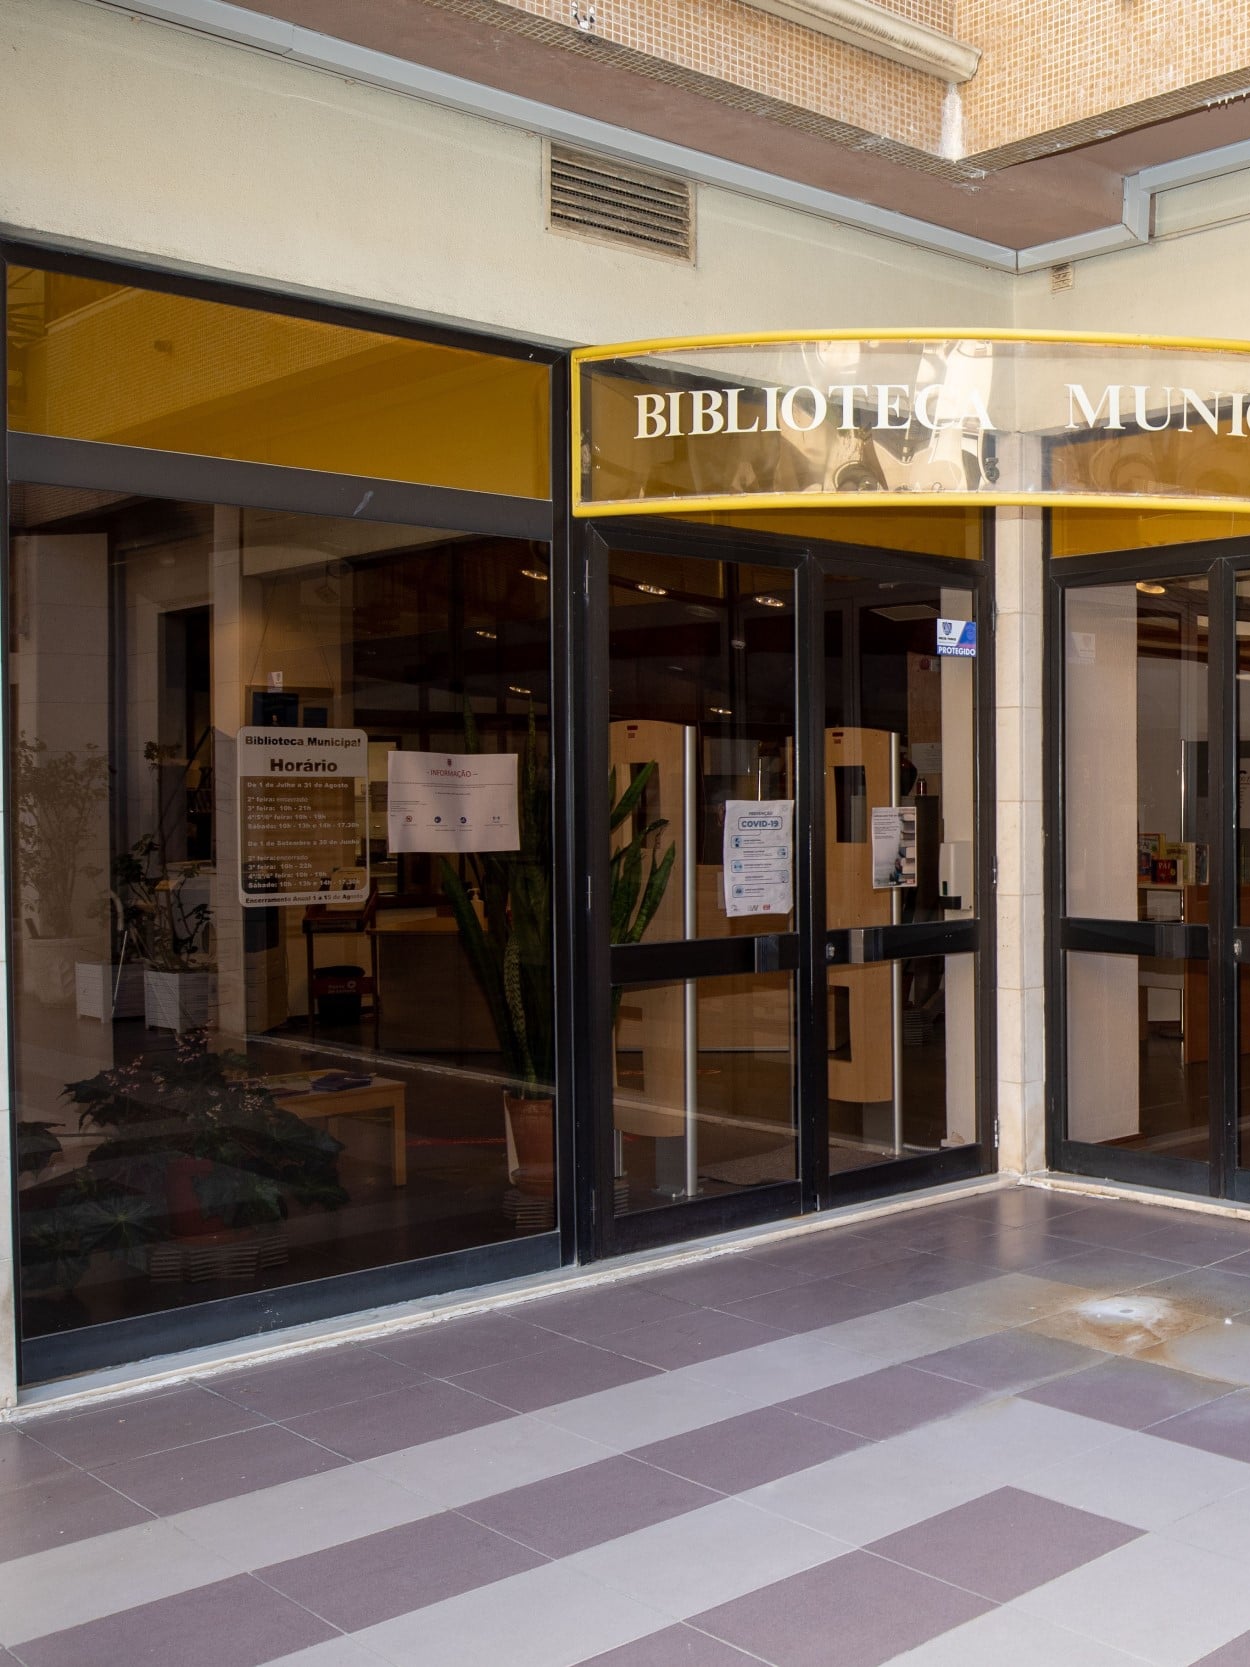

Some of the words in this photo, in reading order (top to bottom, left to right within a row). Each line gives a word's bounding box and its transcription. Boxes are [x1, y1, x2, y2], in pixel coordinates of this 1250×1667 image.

[634, 384, 997, 440] BIBLIOTECA
[938, 646, 976, 656] PROTEGIDO
[245, 735, 304, 746] Biblioteca
[307, 737, 361, 748] Municipal
[270, 758, 337, 772] Horário
[430, 769, 472, 778] INFORMAÇÃO
[324, 782, 349, 790] Agosto
[741, 820, 779, 828] COVID-19
